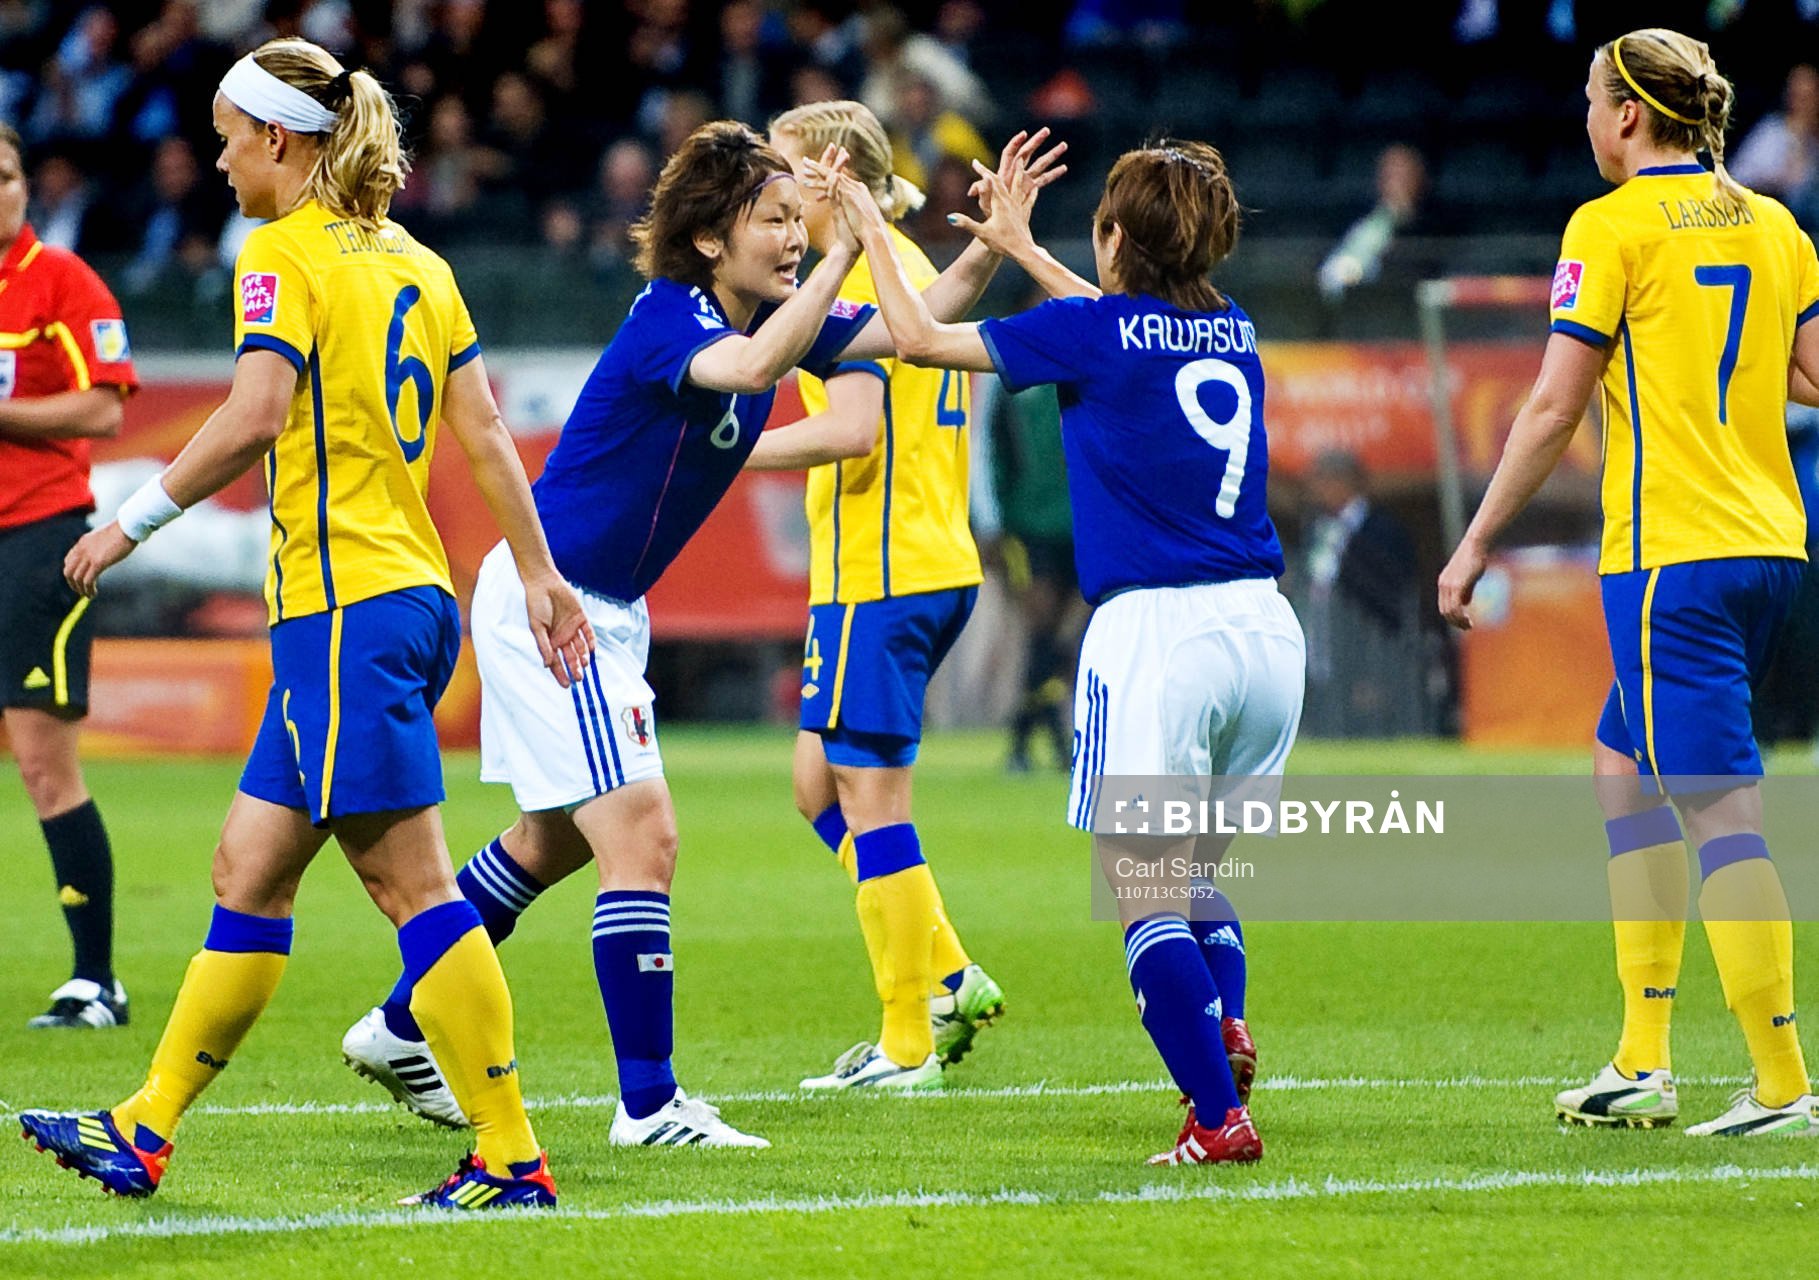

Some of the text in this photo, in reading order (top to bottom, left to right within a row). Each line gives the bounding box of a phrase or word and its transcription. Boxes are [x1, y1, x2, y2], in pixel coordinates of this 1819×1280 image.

[1659, 197, 1756, 229] LARSSON
[385, 284, 434, 464] 6
[1694, 264, 1752, 426] 7
[1174, 358, 1252, 519] 9
